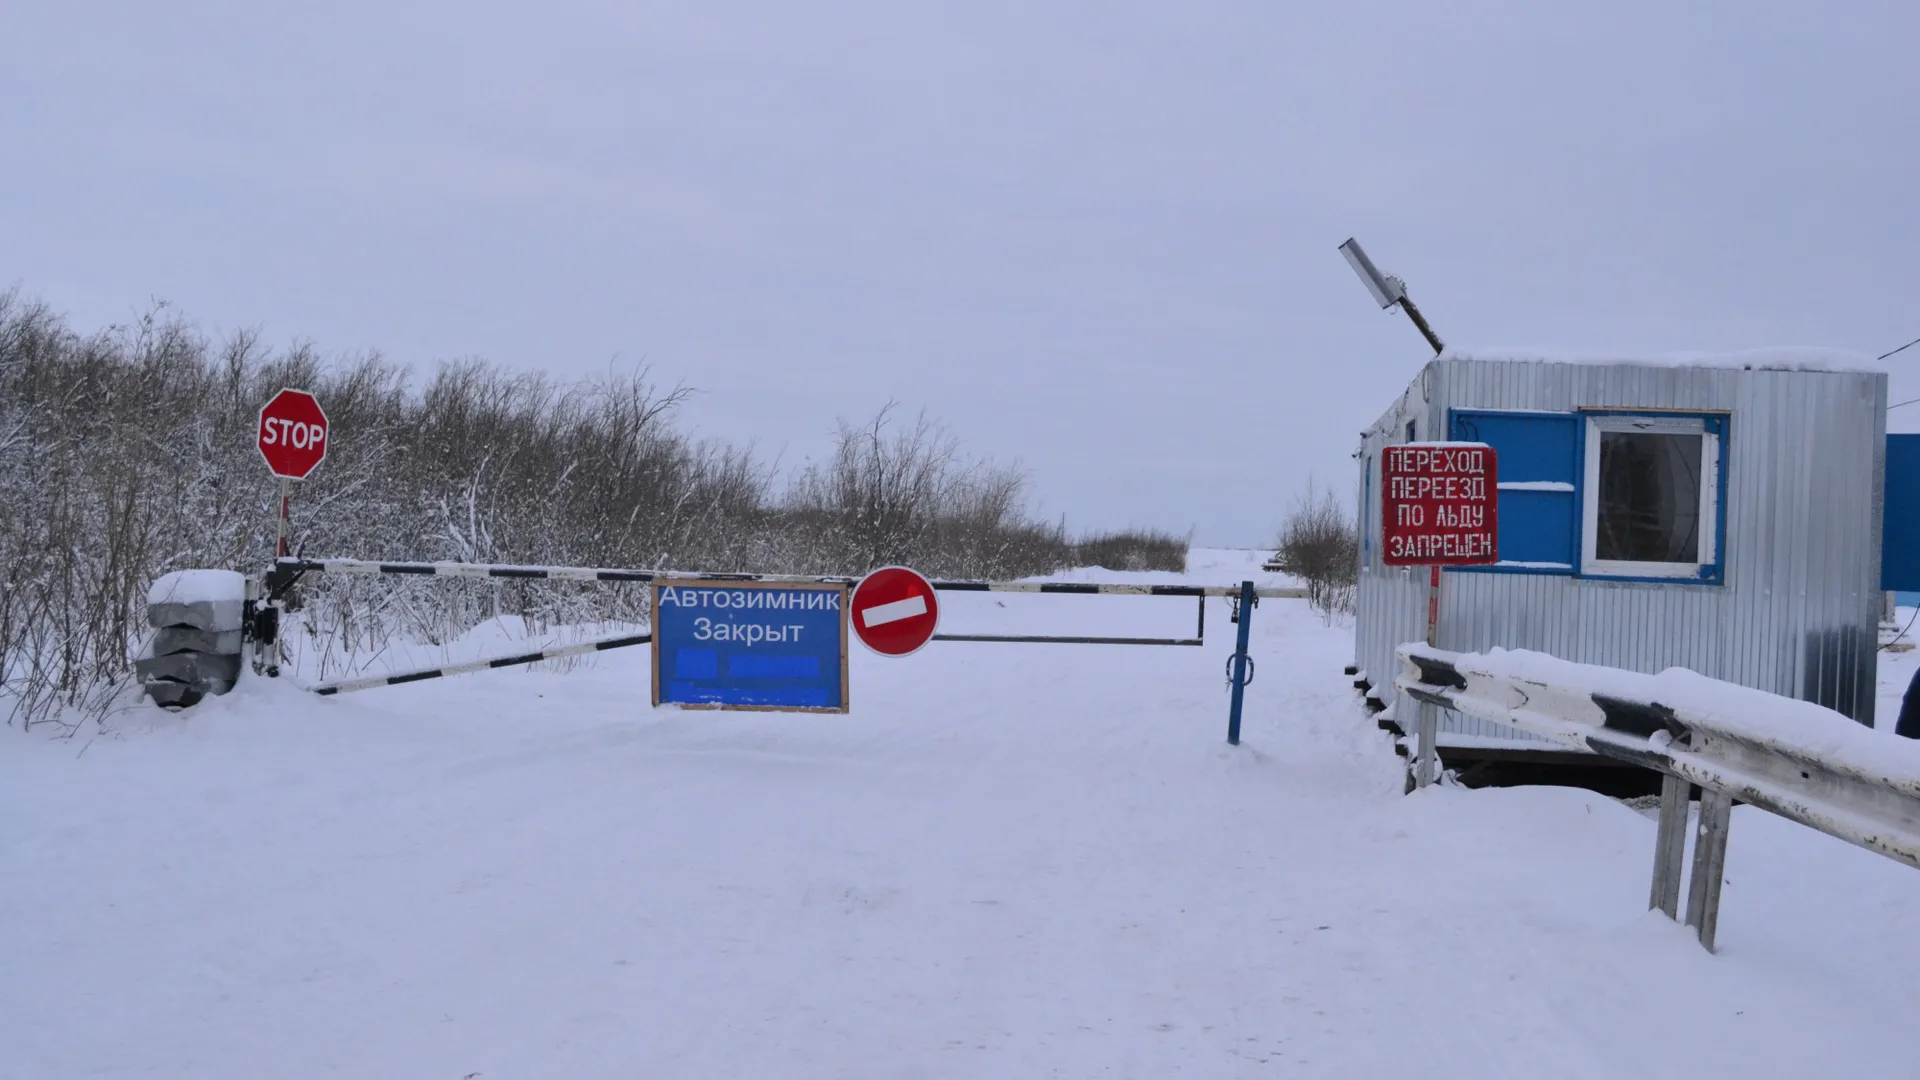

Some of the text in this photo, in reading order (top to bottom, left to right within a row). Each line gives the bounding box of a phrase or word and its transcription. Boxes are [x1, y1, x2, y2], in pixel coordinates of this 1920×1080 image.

[262, 416, 325, 451] STOP
[1389, 450, 1485, 474] ПЕРЕХОД
[1391, 476, 1486, 501] ПЕРЕЕЗД
[1397, 503, 1484, 528] ПО ЛЬДУ
[1390, 532, 1492, 558] ЗАПРЕЩЕН
[658, 586, 840, 611] Автозимник
[693, 617, 804, 647] Закрыт
